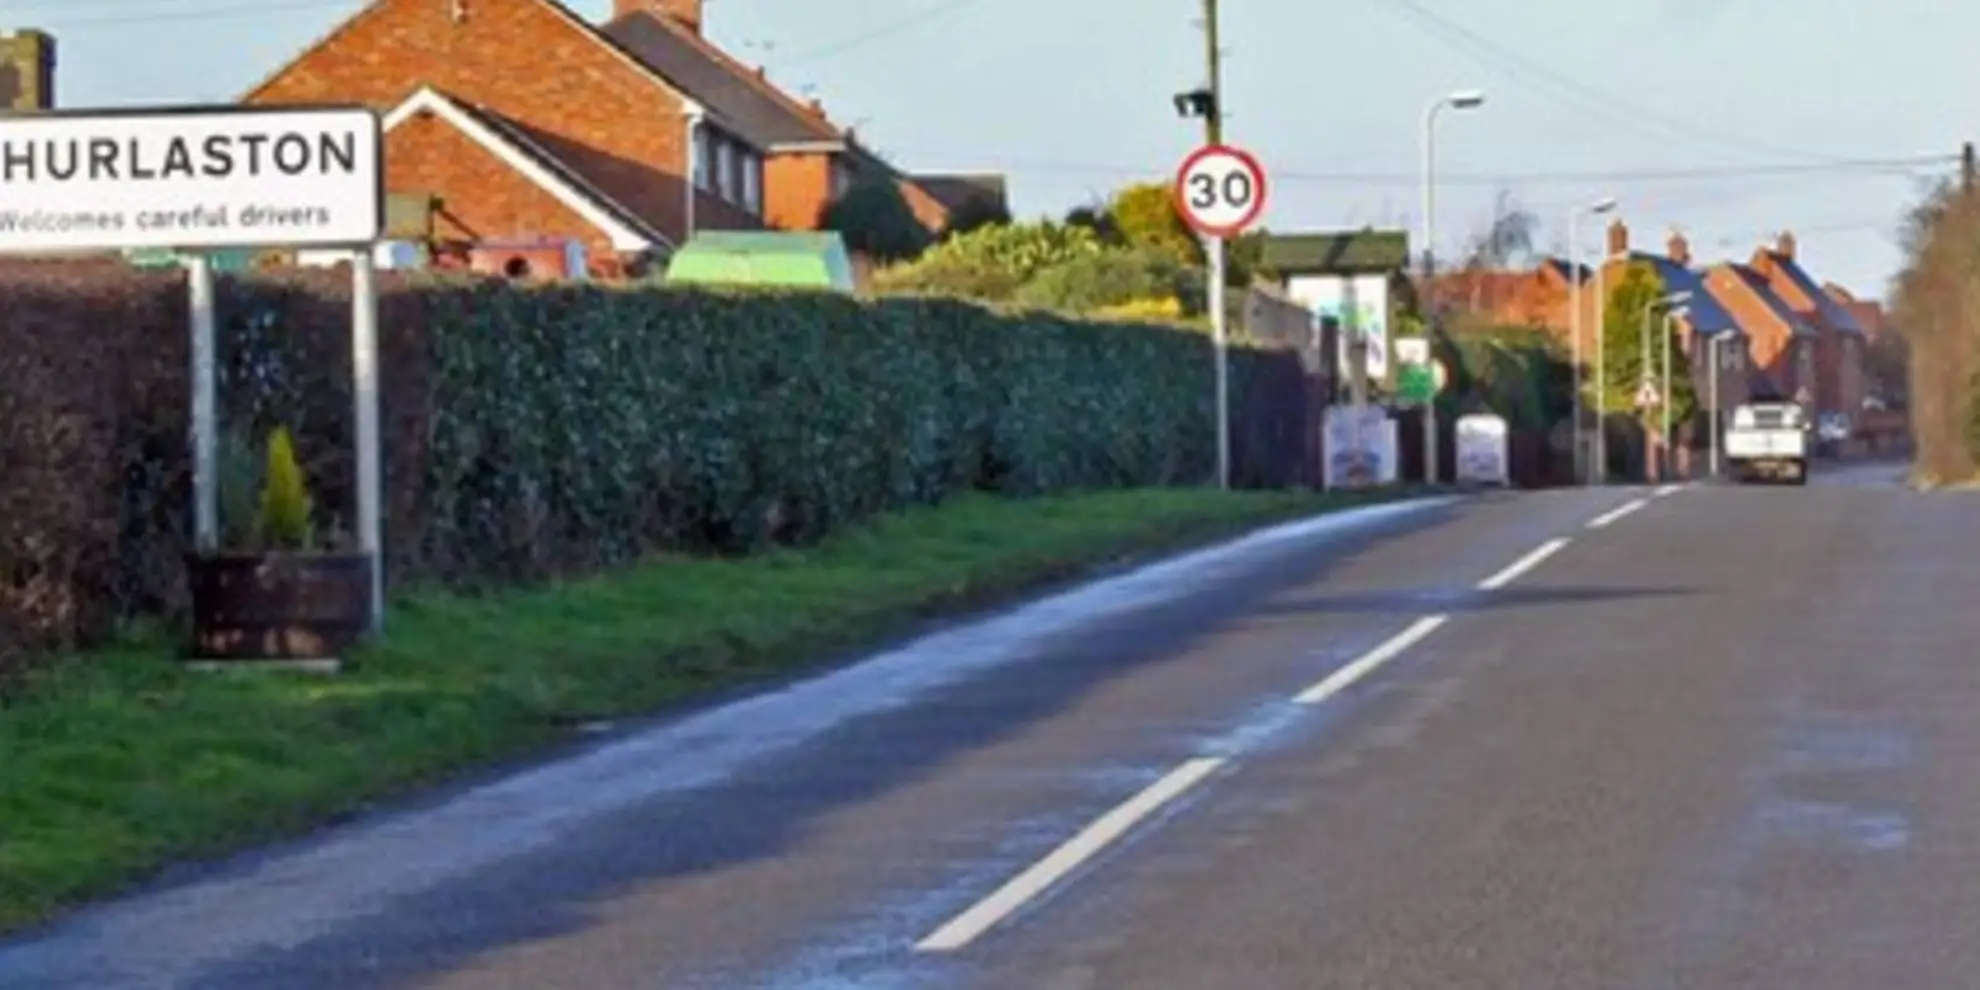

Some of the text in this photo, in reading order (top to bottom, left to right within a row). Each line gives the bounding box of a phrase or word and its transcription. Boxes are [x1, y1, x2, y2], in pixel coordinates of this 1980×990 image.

[1189, 170, 1251, 208] 30
[136, 204, 228, 229] careful
[240, 204, 331, 227] drivers
